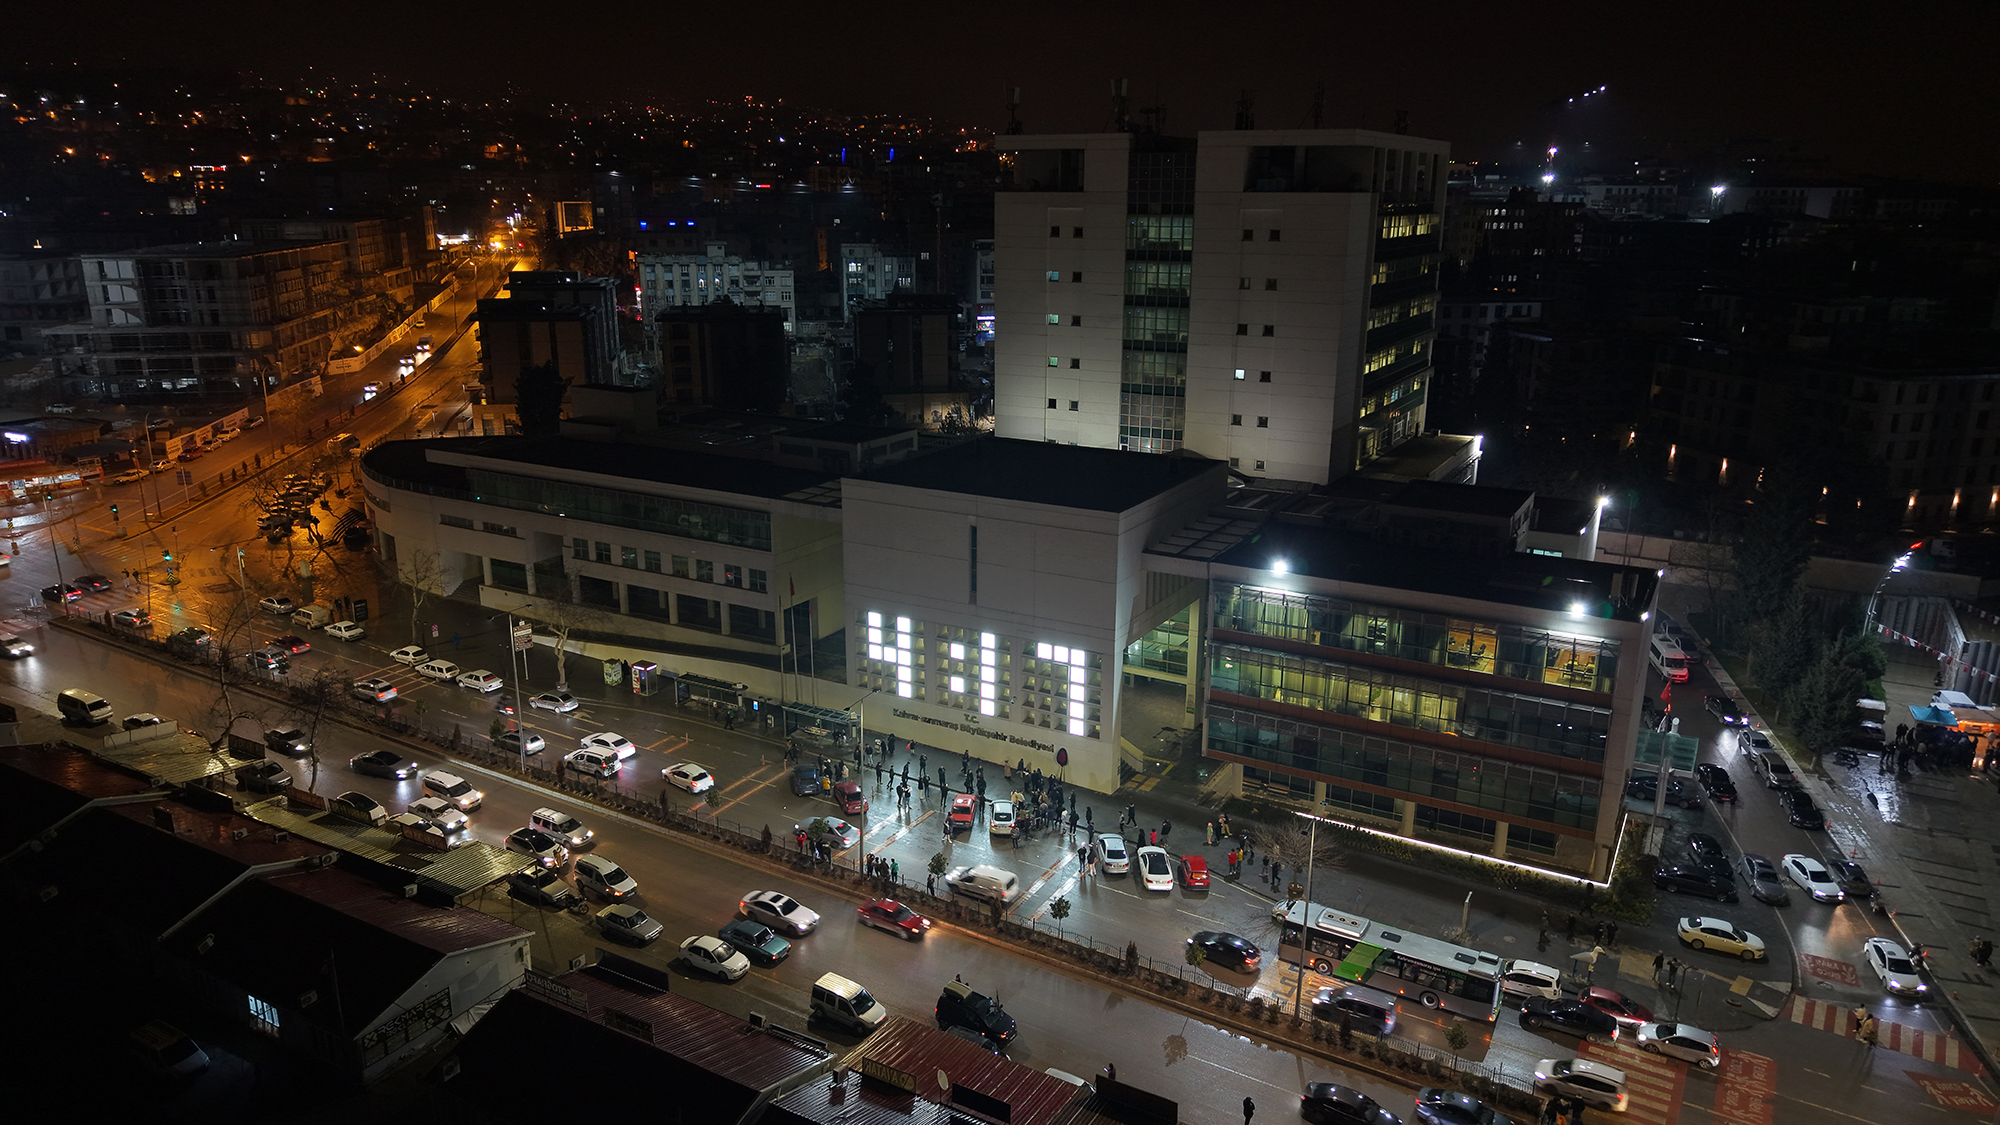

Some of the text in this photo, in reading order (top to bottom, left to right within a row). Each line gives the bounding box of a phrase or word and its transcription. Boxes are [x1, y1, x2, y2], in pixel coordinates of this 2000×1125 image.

[964, 714, 979, 724] T.C.
[960, 723, 1008, 742] Büyükşehir
[1009, 735, 1055, 753] Belediyesi
